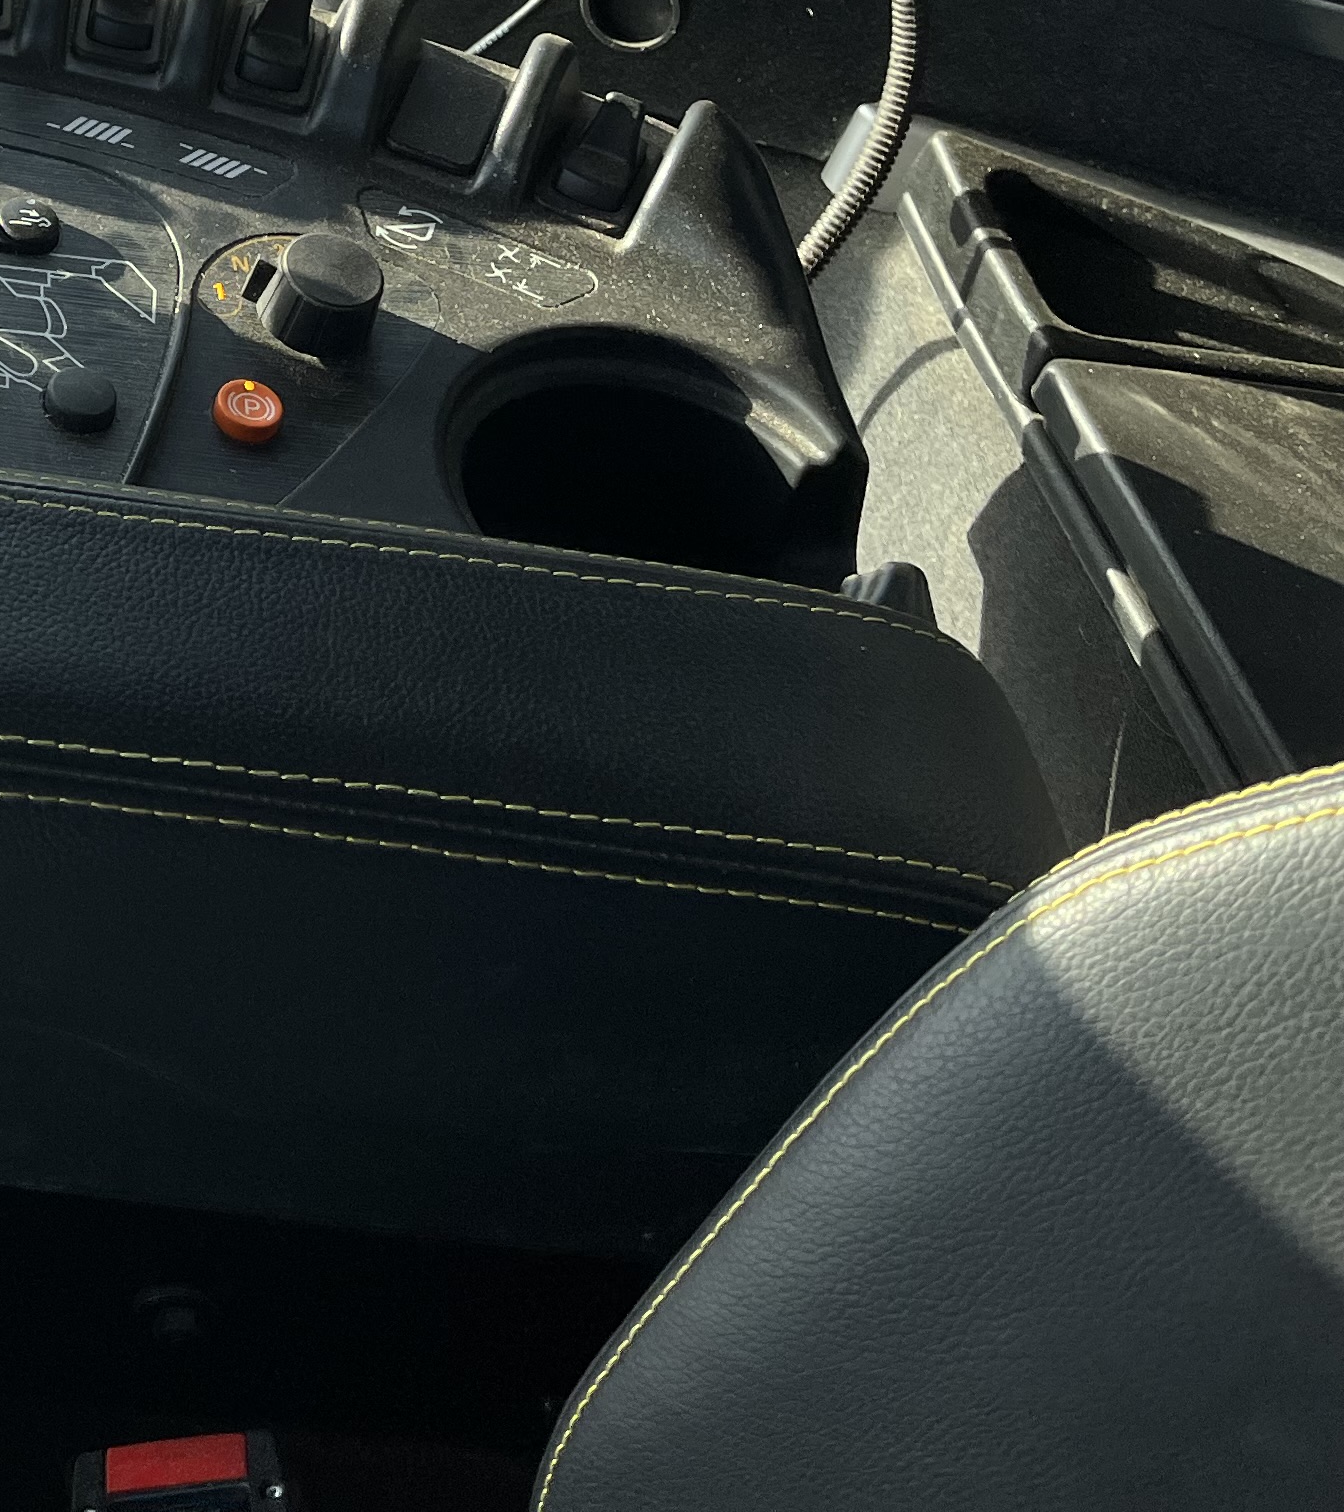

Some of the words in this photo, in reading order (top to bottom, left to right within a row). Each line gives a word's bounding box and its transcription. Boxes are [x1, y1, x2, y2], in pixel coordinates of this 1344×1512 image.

[230, 254, 250, 273] N
[212, 281, 227, 301] 1
[243, 397, 261, 416] P
